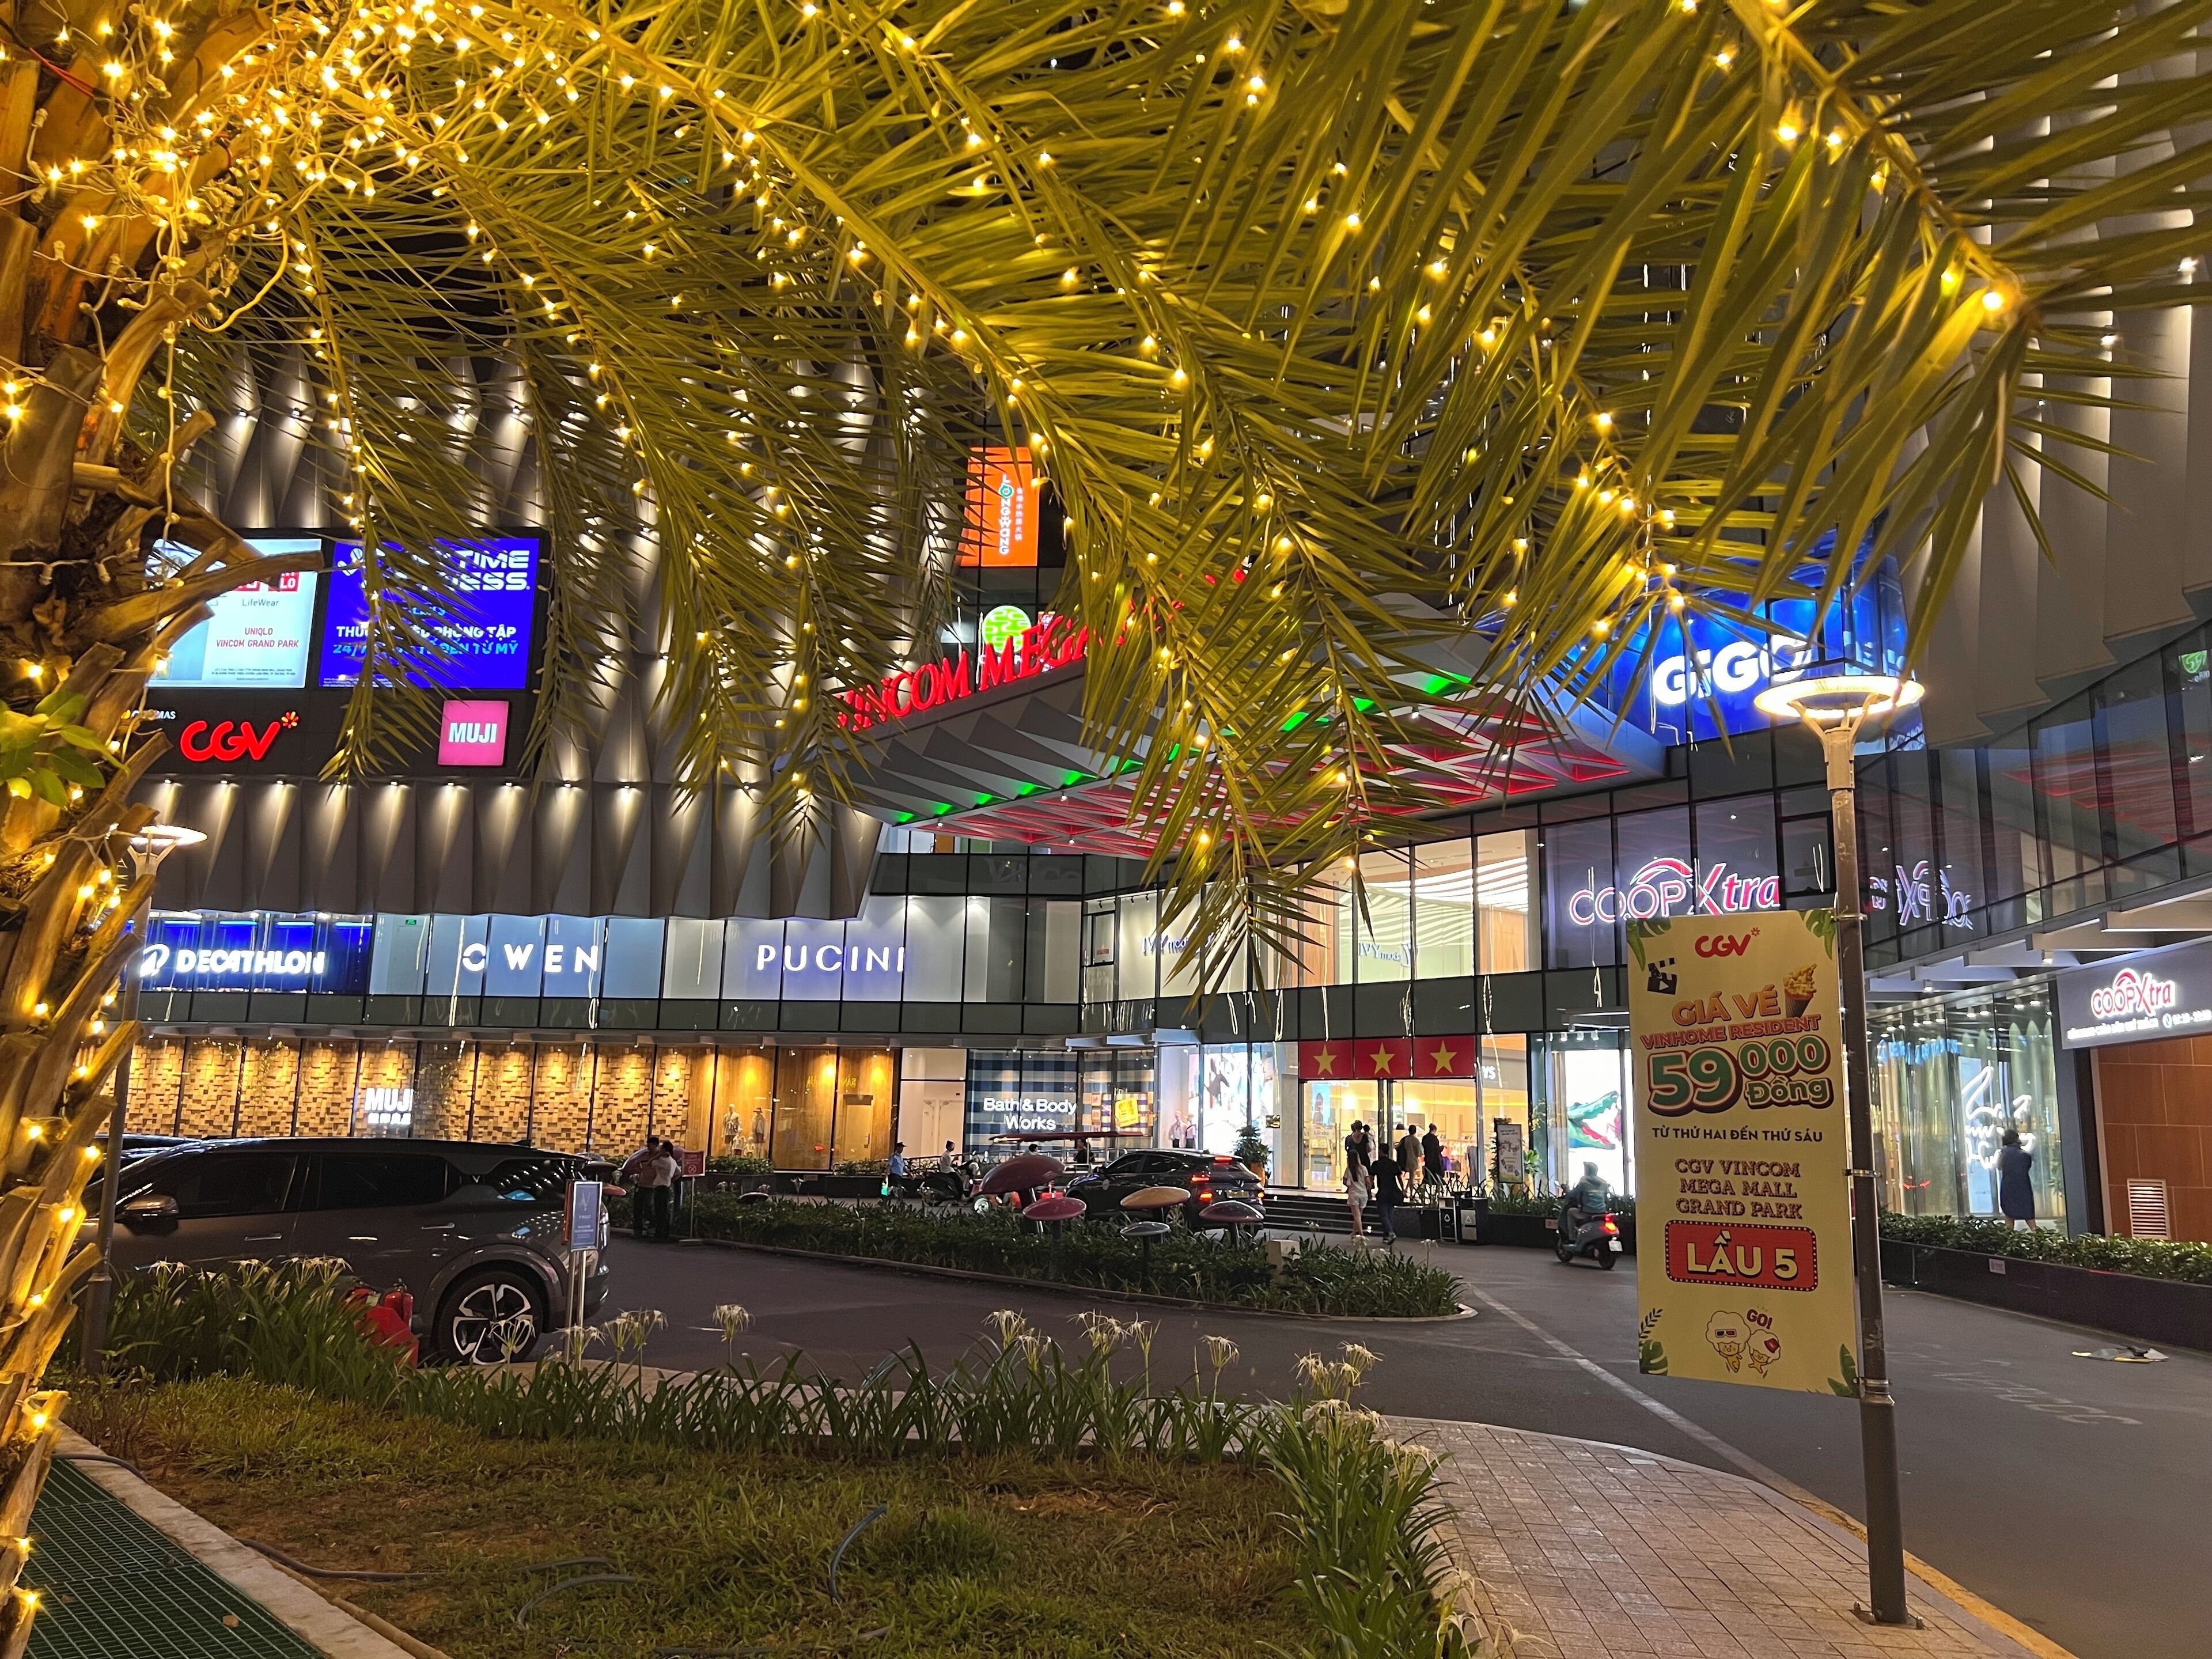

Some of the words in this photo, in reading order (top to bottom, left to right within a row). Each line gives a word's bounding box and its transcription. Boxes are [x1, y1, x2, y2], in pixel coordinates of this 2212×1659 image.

[245, 627, 273, 636] UNIQLO
[217, 639, 244, 647] VINCOM
[248, 639, 275, 647] GRAND
[278, 640, 299, 648] PARK
[180, 720, 281, 762] CGV
[448, 724, 498, 744] MUJI
[1358, 942, 1381, 959] IVY
[1695, 934, 1751, 958] CGV
[176, 949, 325, 974] DECATHLON
[462, 942, 599, 973] OWEN
[756, 945, 906, 972] PUCINI
[1672, 990, 1731, 1026] GIÁ
[1732, 984, 1781, 1018] VÉ
[1640, 1026, 1727, 1049] VINHOME
[1730, 1014, 1821, 1039] RESIDENT
[364, 1088, 414, 1112] MUJI
[1745, 1074, 1834, 1109] Đồng
[983, 1098, 1020, 1112] Bath
[1022, 1099, 1034, 1112] &
[1036, 1099, 1077, 1115] Body
[1005, 1115, 1056, 1130] Works
[1653, 1124, 1670, 1139] TỪ
[1673, 1126, 1700, 1140] THỨ
[1704, 1130, 1726, 1141] HAI
[1730, 1125, 1758, 1141] ĐẾN
[1762, 1127, 1791, 1142] THỨ
[1794, 1127, 1823, 1143] SÁU
[1675, 1158, 1714, 1174] CGV
[1718, 1160, 1801, 1177] VINCOM
[1679, 1178, 1736, 1195] MEGA
[1741, 1180, 1797, 1198] MALL
[1676, 1198, 1745, 1217] GRAND
[1750, 1202, 1802, 1219] PARK
[1687, 1230, 1763, 1278] LẦU
[1774, 1248, 1800, 1281] 5
[1747, 1309, 1773, 1330] GO!
